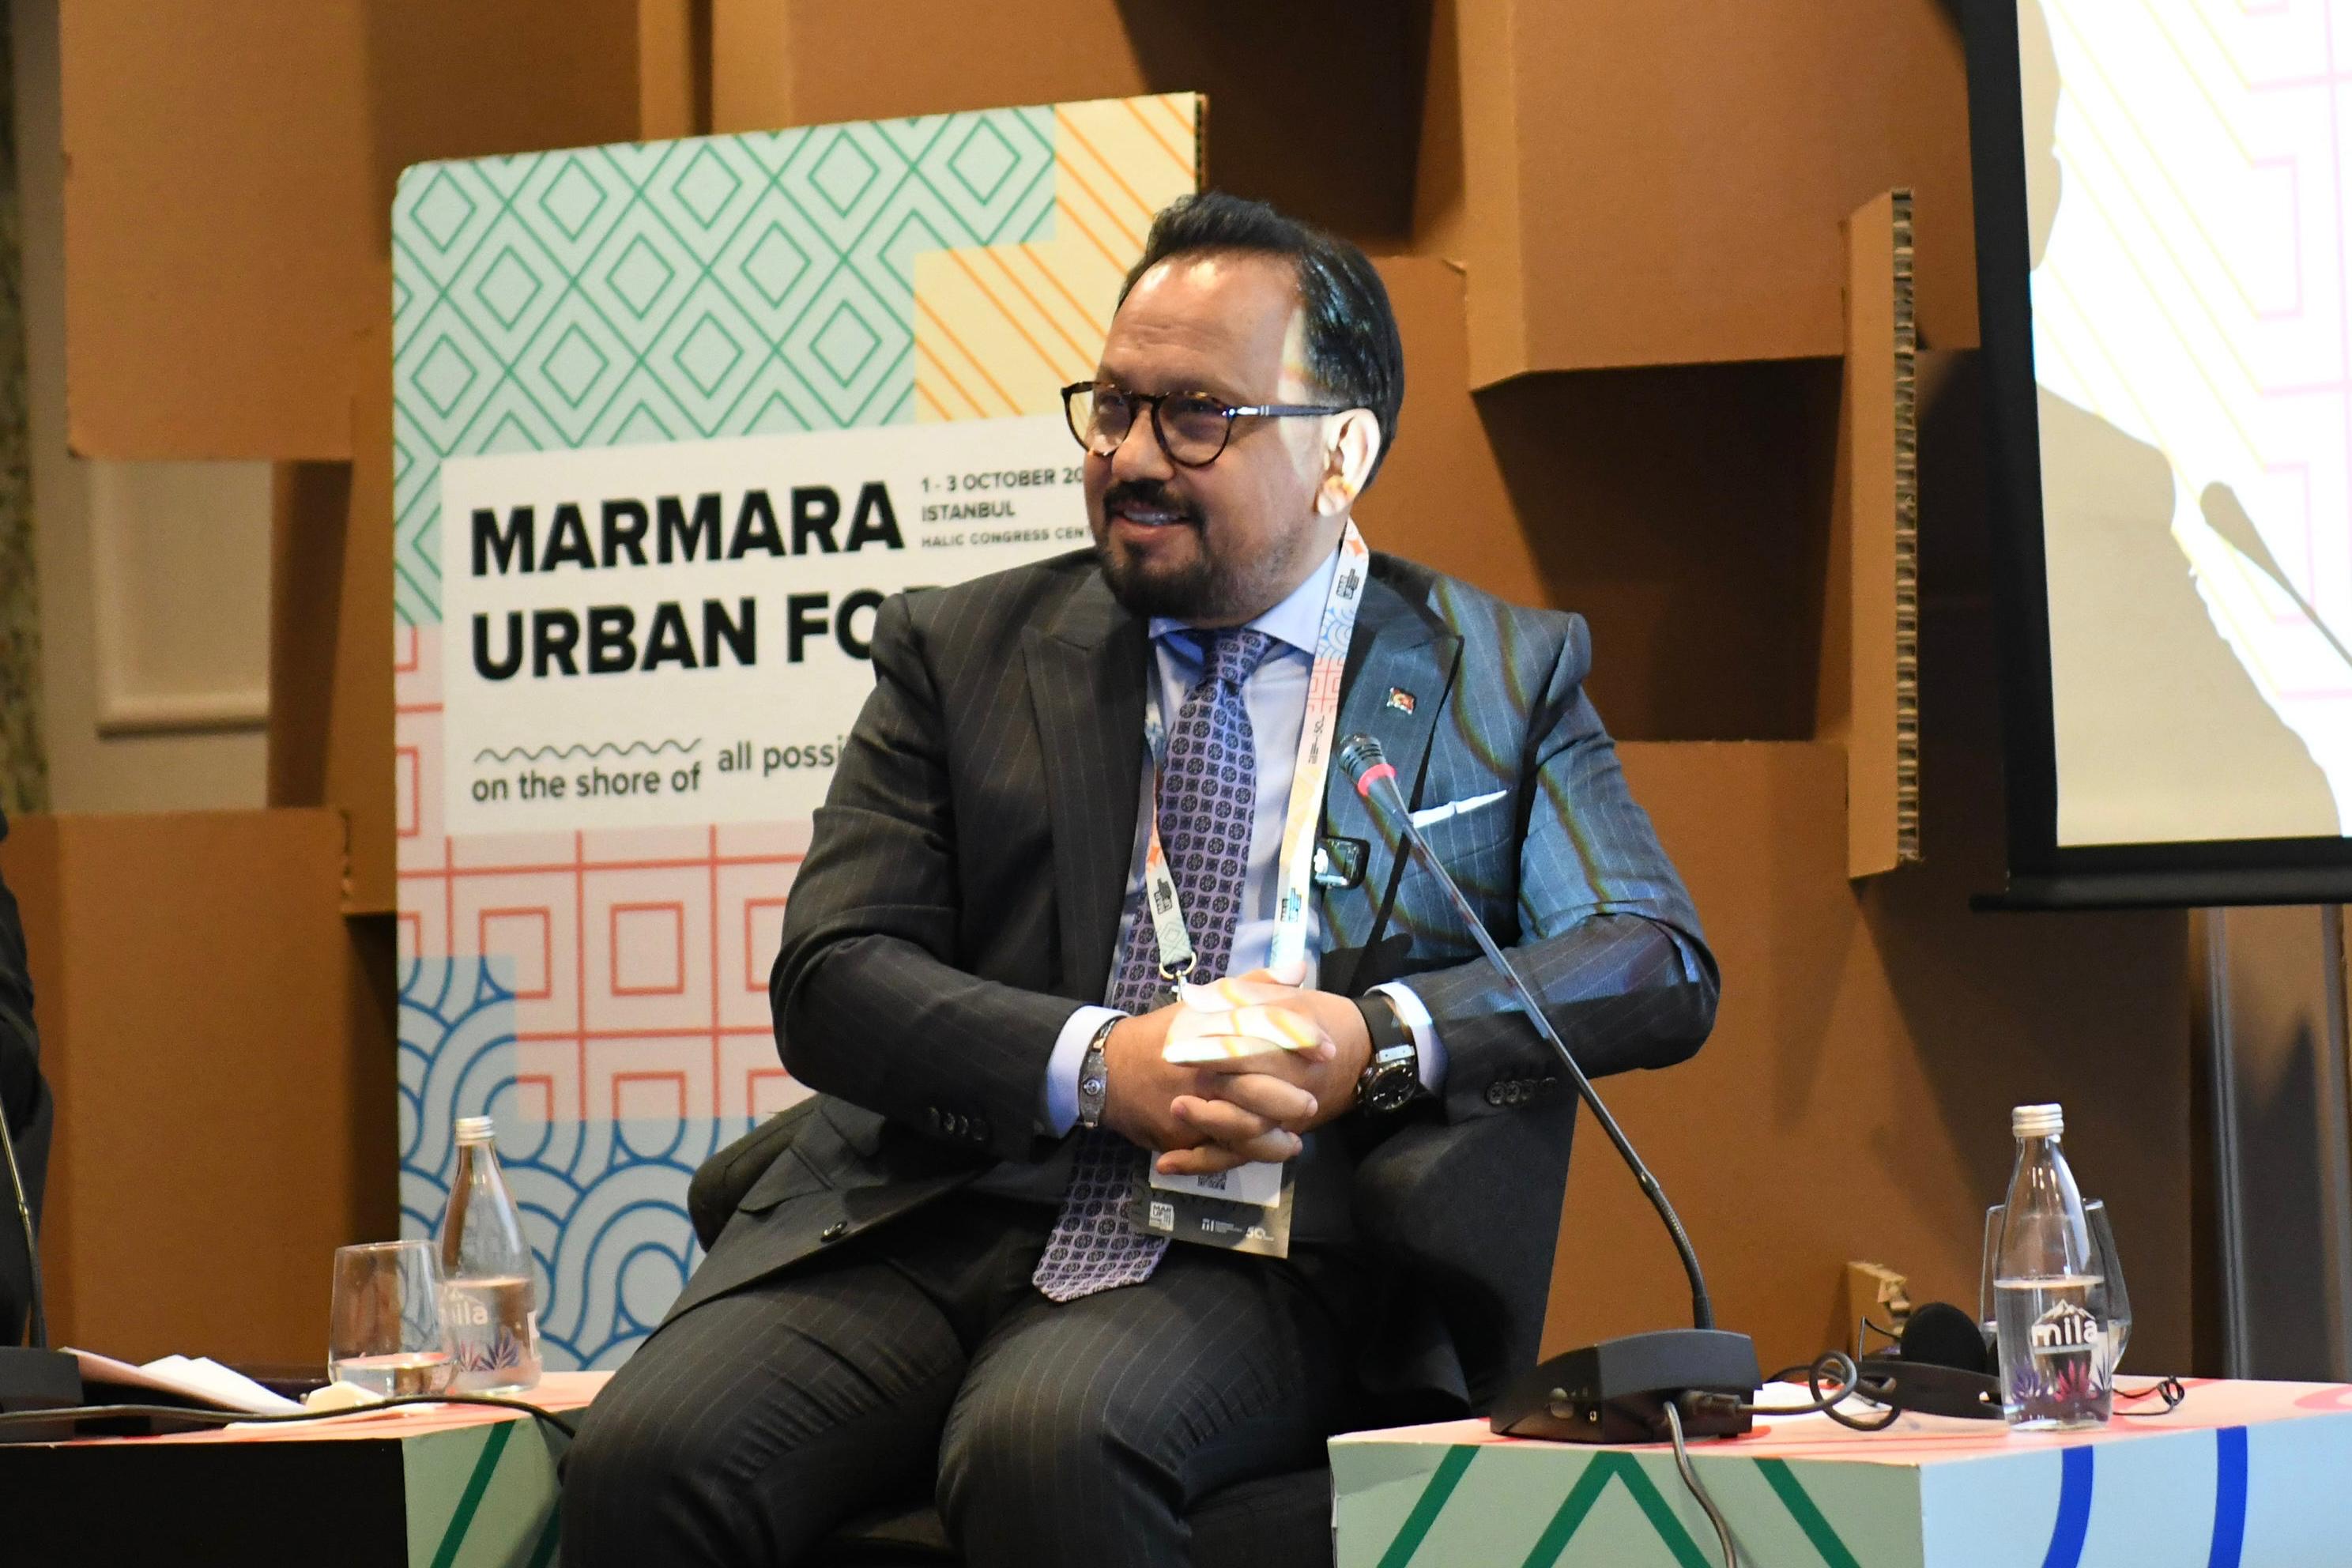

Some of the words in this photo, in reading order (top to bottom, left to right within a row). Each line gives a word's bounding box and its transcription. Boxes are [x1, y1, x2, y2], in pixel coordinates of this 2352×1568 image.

[922, 477, 929, 492] 1
[948, 475, 957, 492] 3
[963, 468, 1057, 491] OCTOBER
[922, 500, 1016, 522] ISTANBUL
[472, 481, 905, 577] MARMARA
[922, 533, 965, 548] HALIC
[969, 528, 1050, 545] CONGRESS
[472, 597, 756, 681] URBAN
[787, 586, 940, 663] FO
[718, 741, 752, 772] all
[472, 778, 509, 803] on
[518, 769, 567, 801] the
[575, 767, 661, 797] shore
[670, 760, 702, 793] of
[2031, 1314, 2098, 1348] mila
